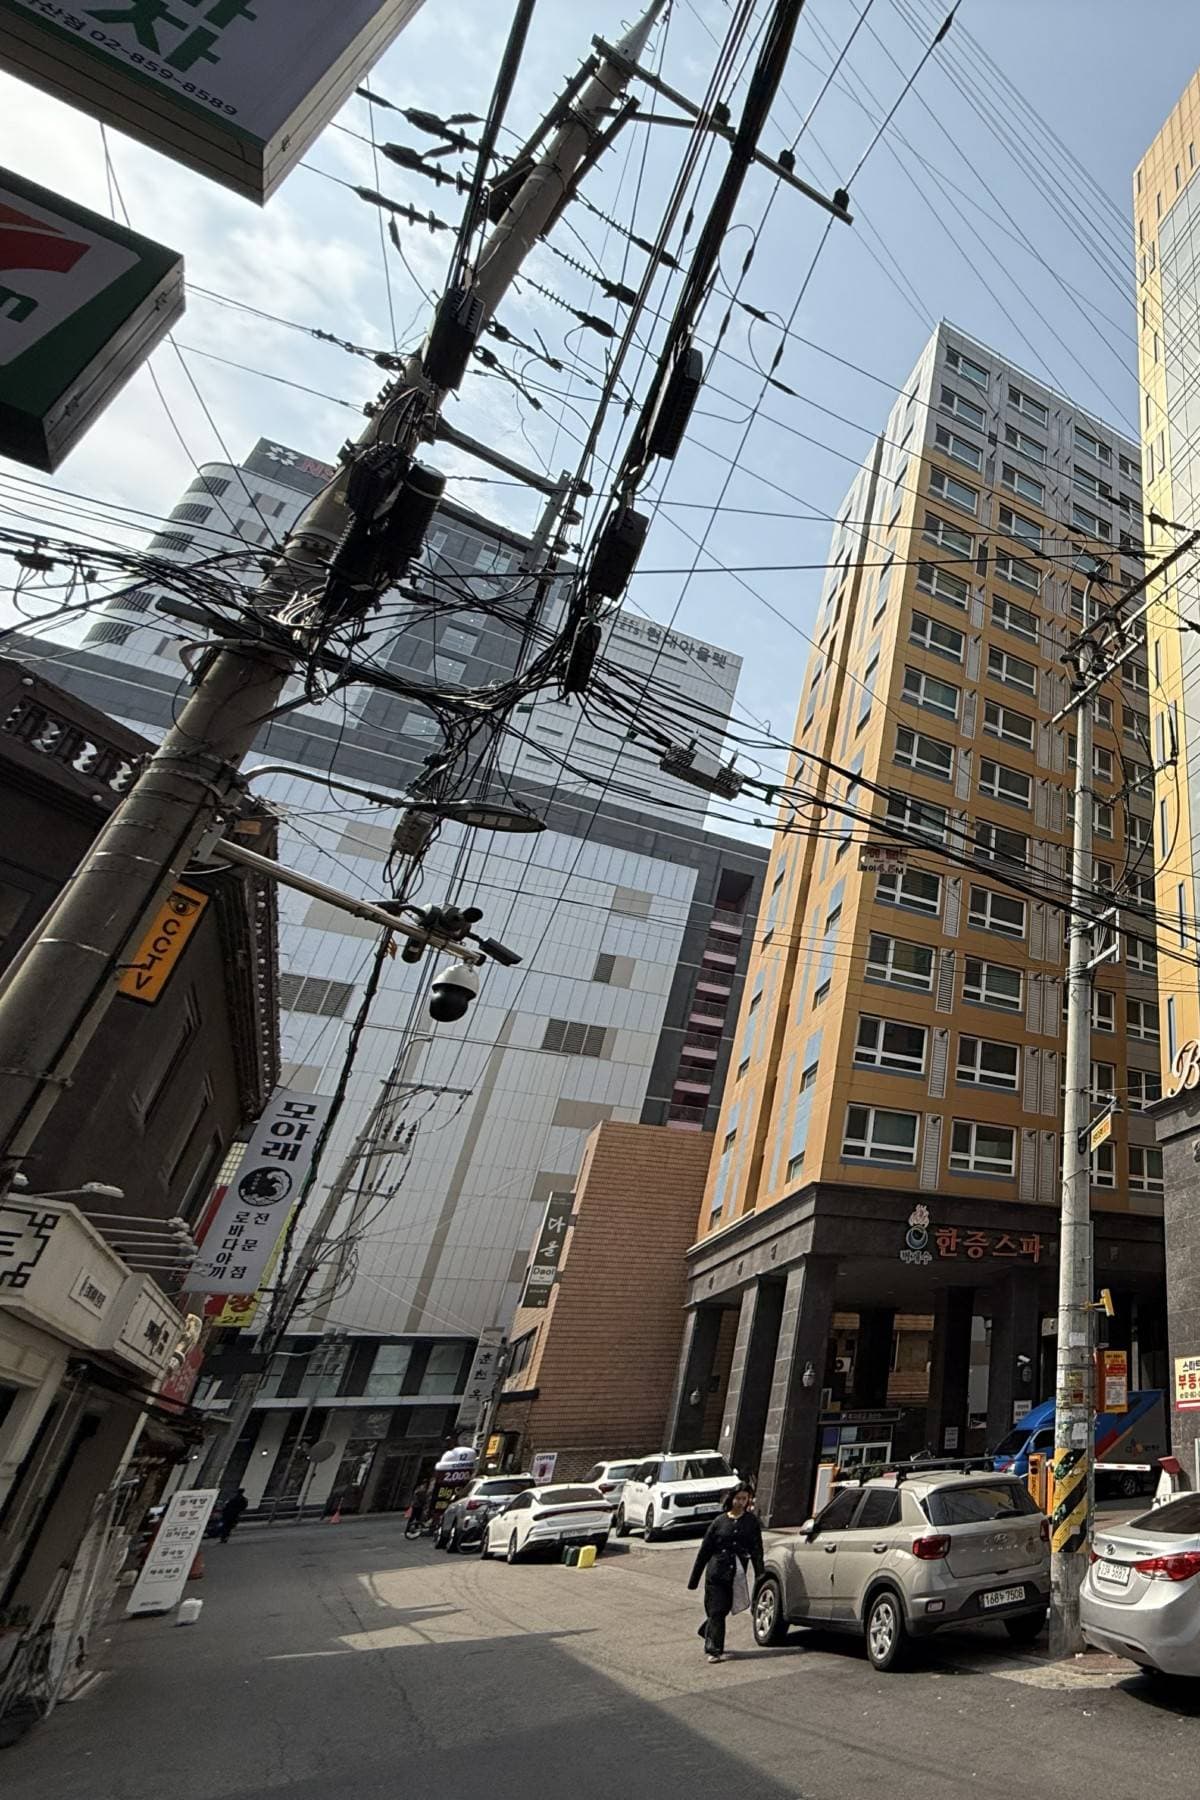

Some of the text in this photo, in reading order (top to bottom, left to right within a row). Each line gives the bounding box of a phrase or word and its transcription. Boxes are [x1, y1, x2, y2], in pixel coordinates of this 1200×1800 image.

[89, 29, 238, 117] 02-859-8589
[135, 918, 181, 990] CCTV
[261, 1100, 318, 1162] 모아래
[207, 1210, 251, 1280] 로바다야끼
[229, 1211, 271, 1280] 전문점
[934, 1226, 1044, 1264] 한증스파
